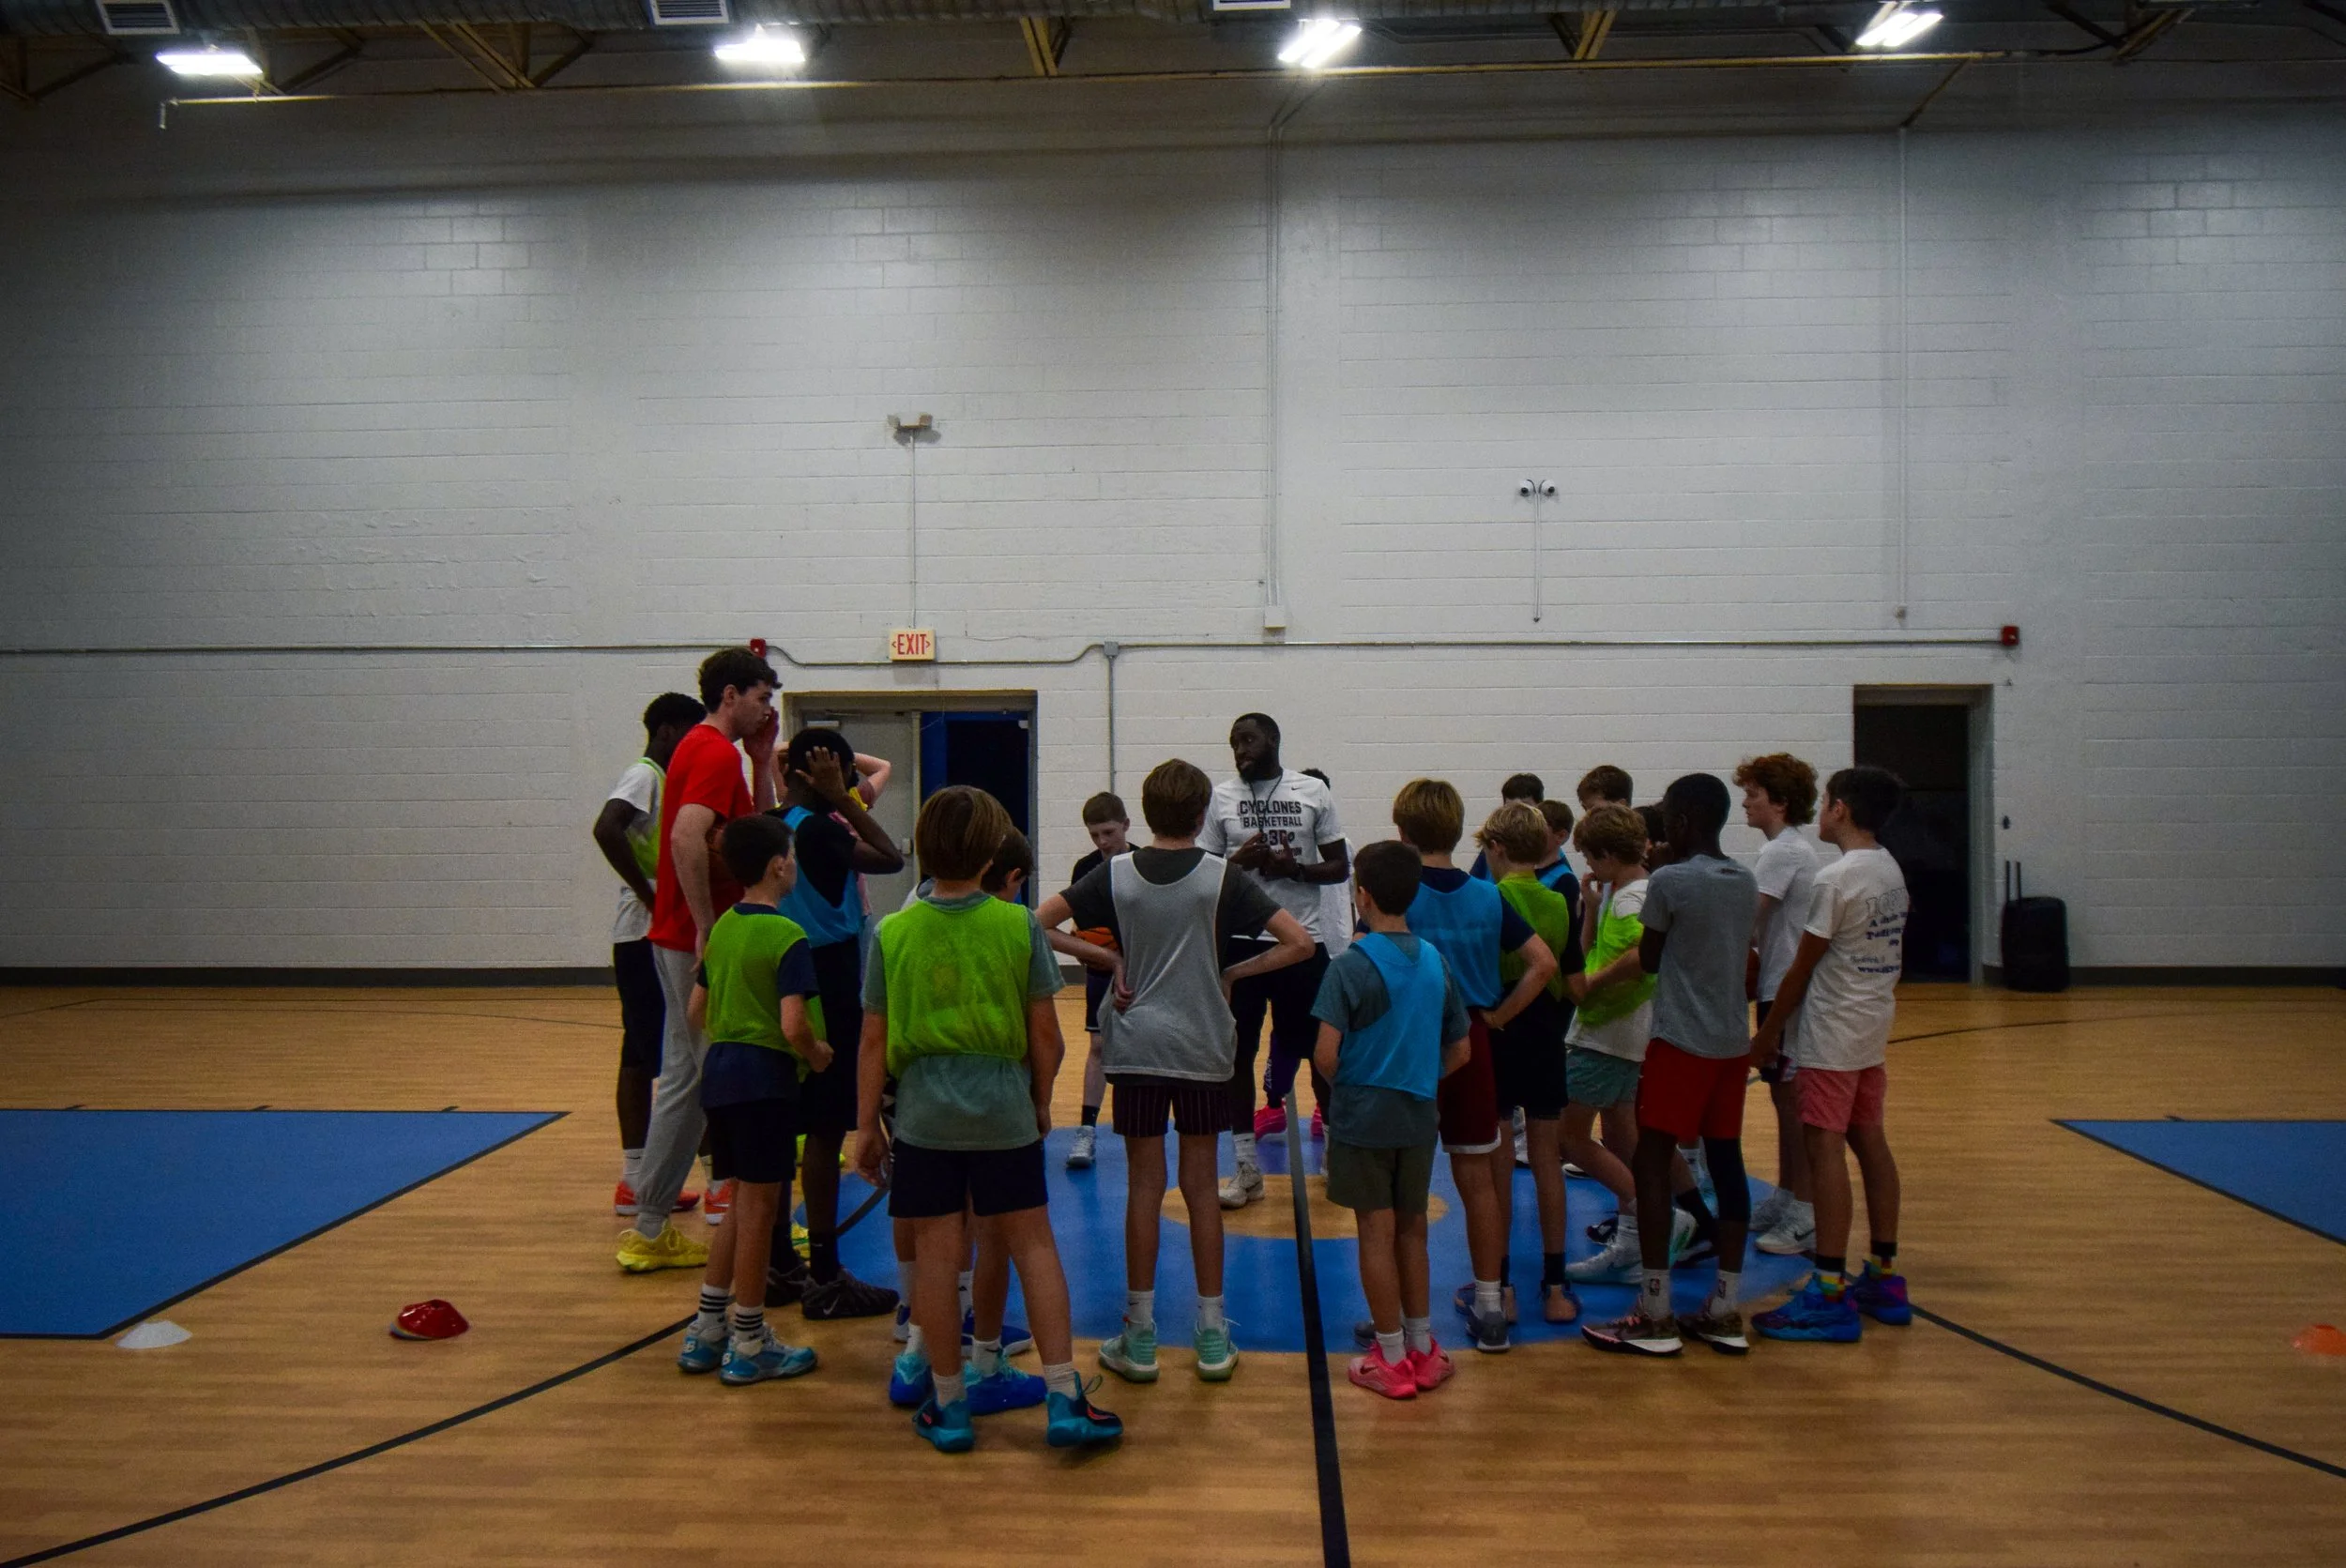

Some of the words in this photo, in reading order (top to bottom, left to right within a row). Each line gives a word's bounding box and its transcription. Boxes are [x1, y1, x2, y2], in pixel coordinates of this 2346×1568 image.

[897, 633, 927, 655] EXIT
[1239, 799, 1302, 814] CYCLONES
[1242, 815, 1303, 828] BASKETBALL
